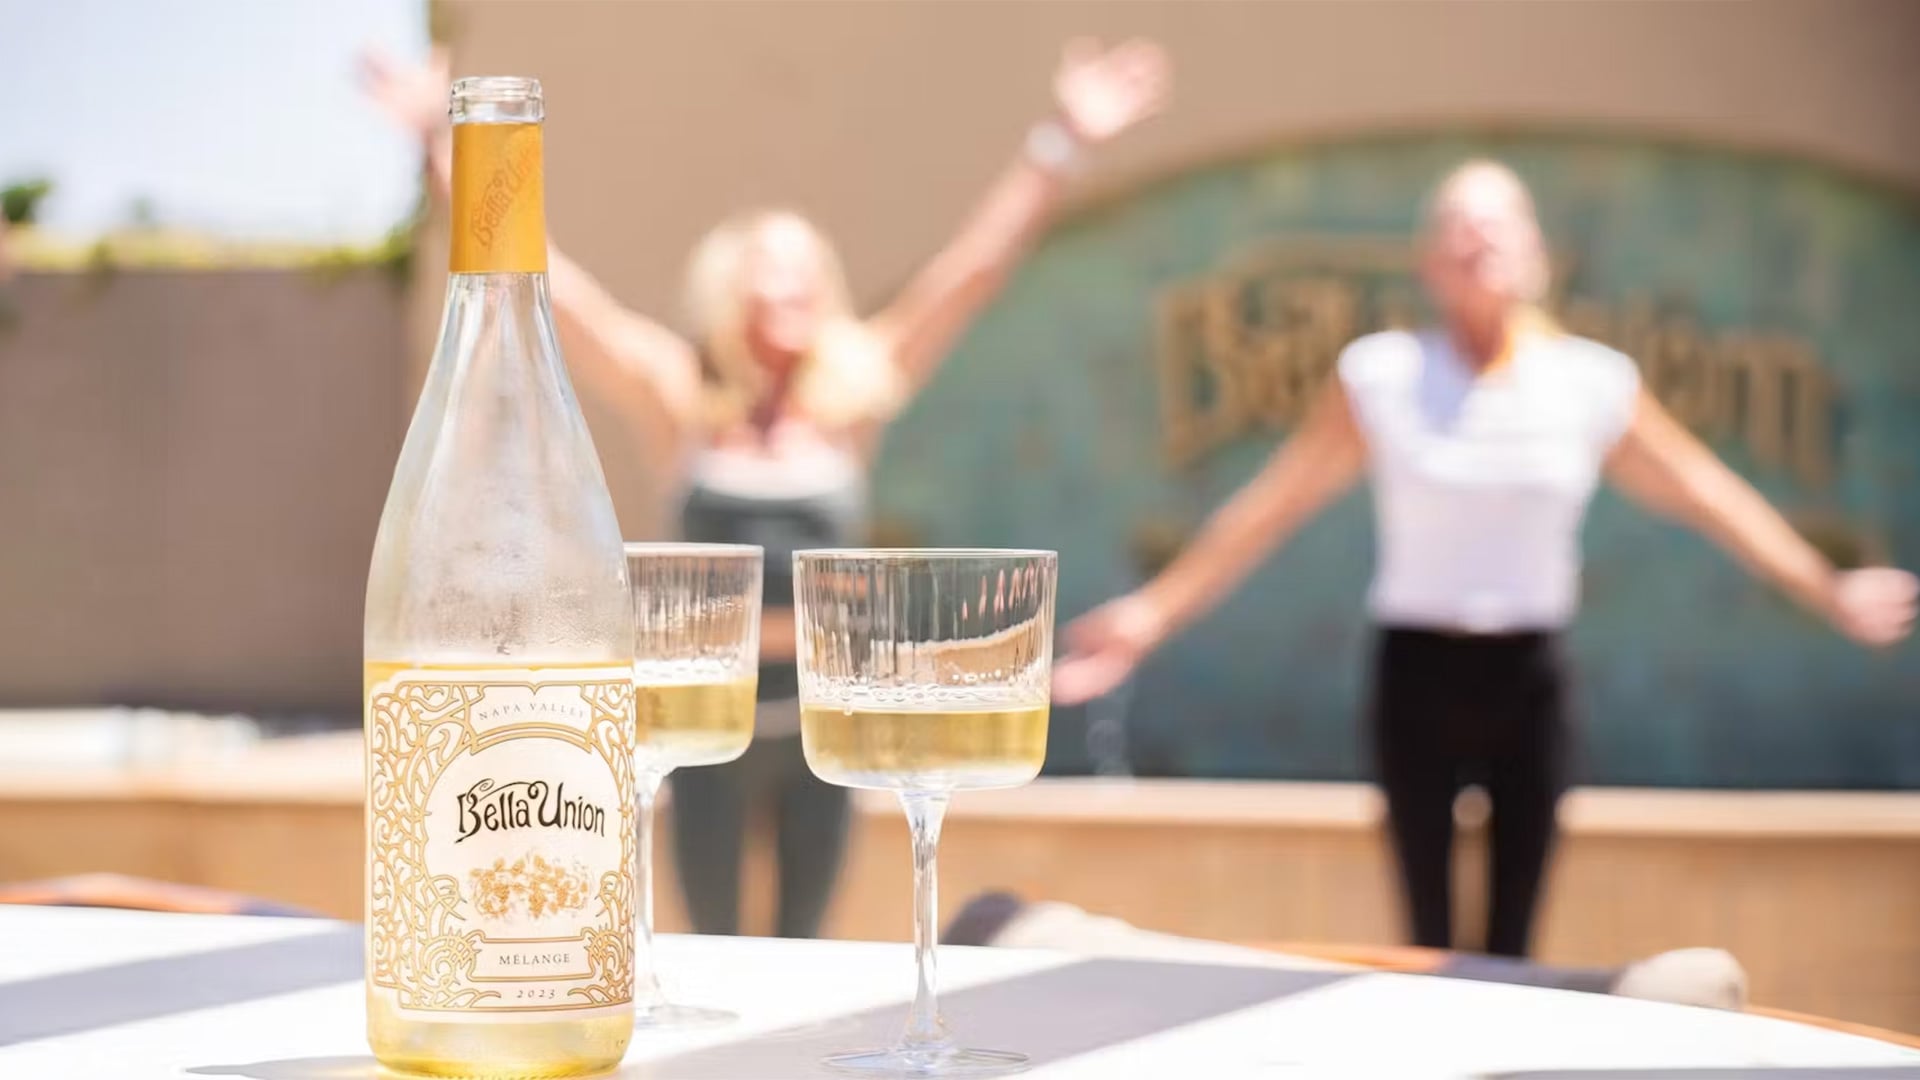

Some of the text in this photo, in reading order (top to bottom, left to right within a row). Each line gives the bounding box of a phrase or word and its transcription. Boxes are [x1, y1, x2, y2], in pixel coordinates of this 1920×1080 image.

[469, 184, 511, 251] Bella
[479, 702, 587, 721] NAPA VALLEY
[455, 778, 605, 844] Bella Union
[516, 988, 556, 1000] 2023
